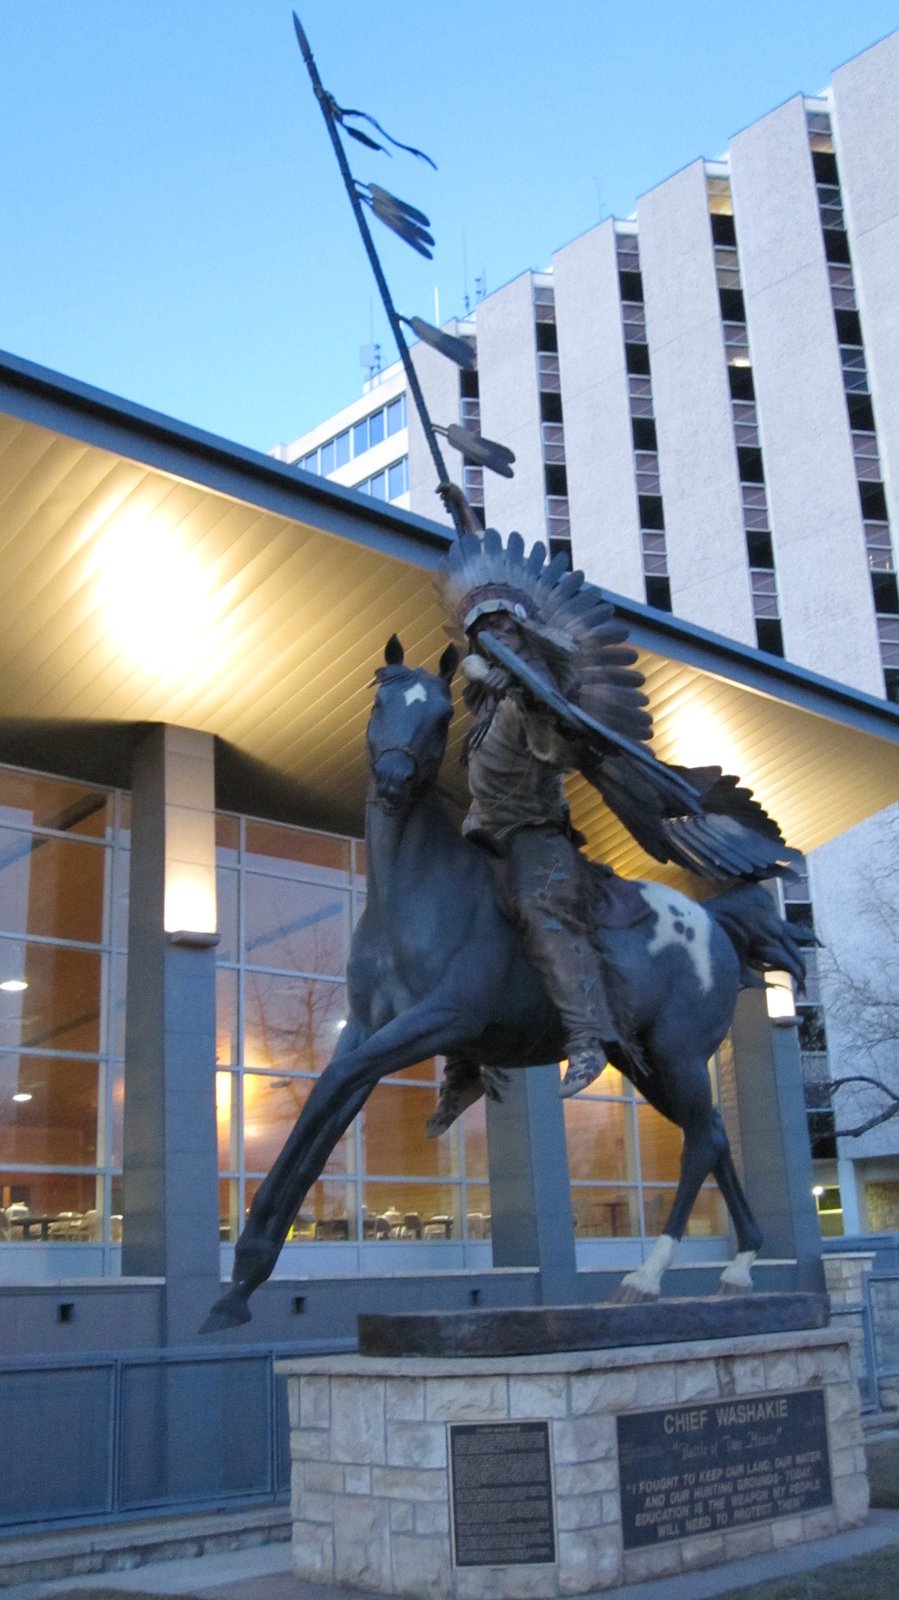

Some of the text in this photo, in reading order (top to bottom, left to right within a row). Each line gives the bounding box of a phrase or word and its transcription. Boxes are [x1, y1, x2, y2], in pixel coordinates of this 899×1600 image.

[663, 1399, 788, 1434] CHIEF WASHAKIE
[638, 1476, 679, 1494] FOUGHT
[683, 1472, 696, 1486] TO
[699, 1468, 723, 1482] KEEP
[725, 1463, 744, 1478] OUR
[774, 1455, 793, 1469] OUR
[795, 1450, 822, 1465] WATER
[635, 1478, 821, 1527] EDUCATION IS THE WEAPON MY PEOPLE
[643, 1494, 666, 1510] AND
[669, 1489, 690, 1504] OUR
[693, 1481, 734, 1500] HUNTING
[657, 1522, 680, 1538] WILL
[685, 1516, 712, 1531] NEED
[716, 1512, 728, 1525] TO
[733, 1503, 772, 1521] PROTECT
